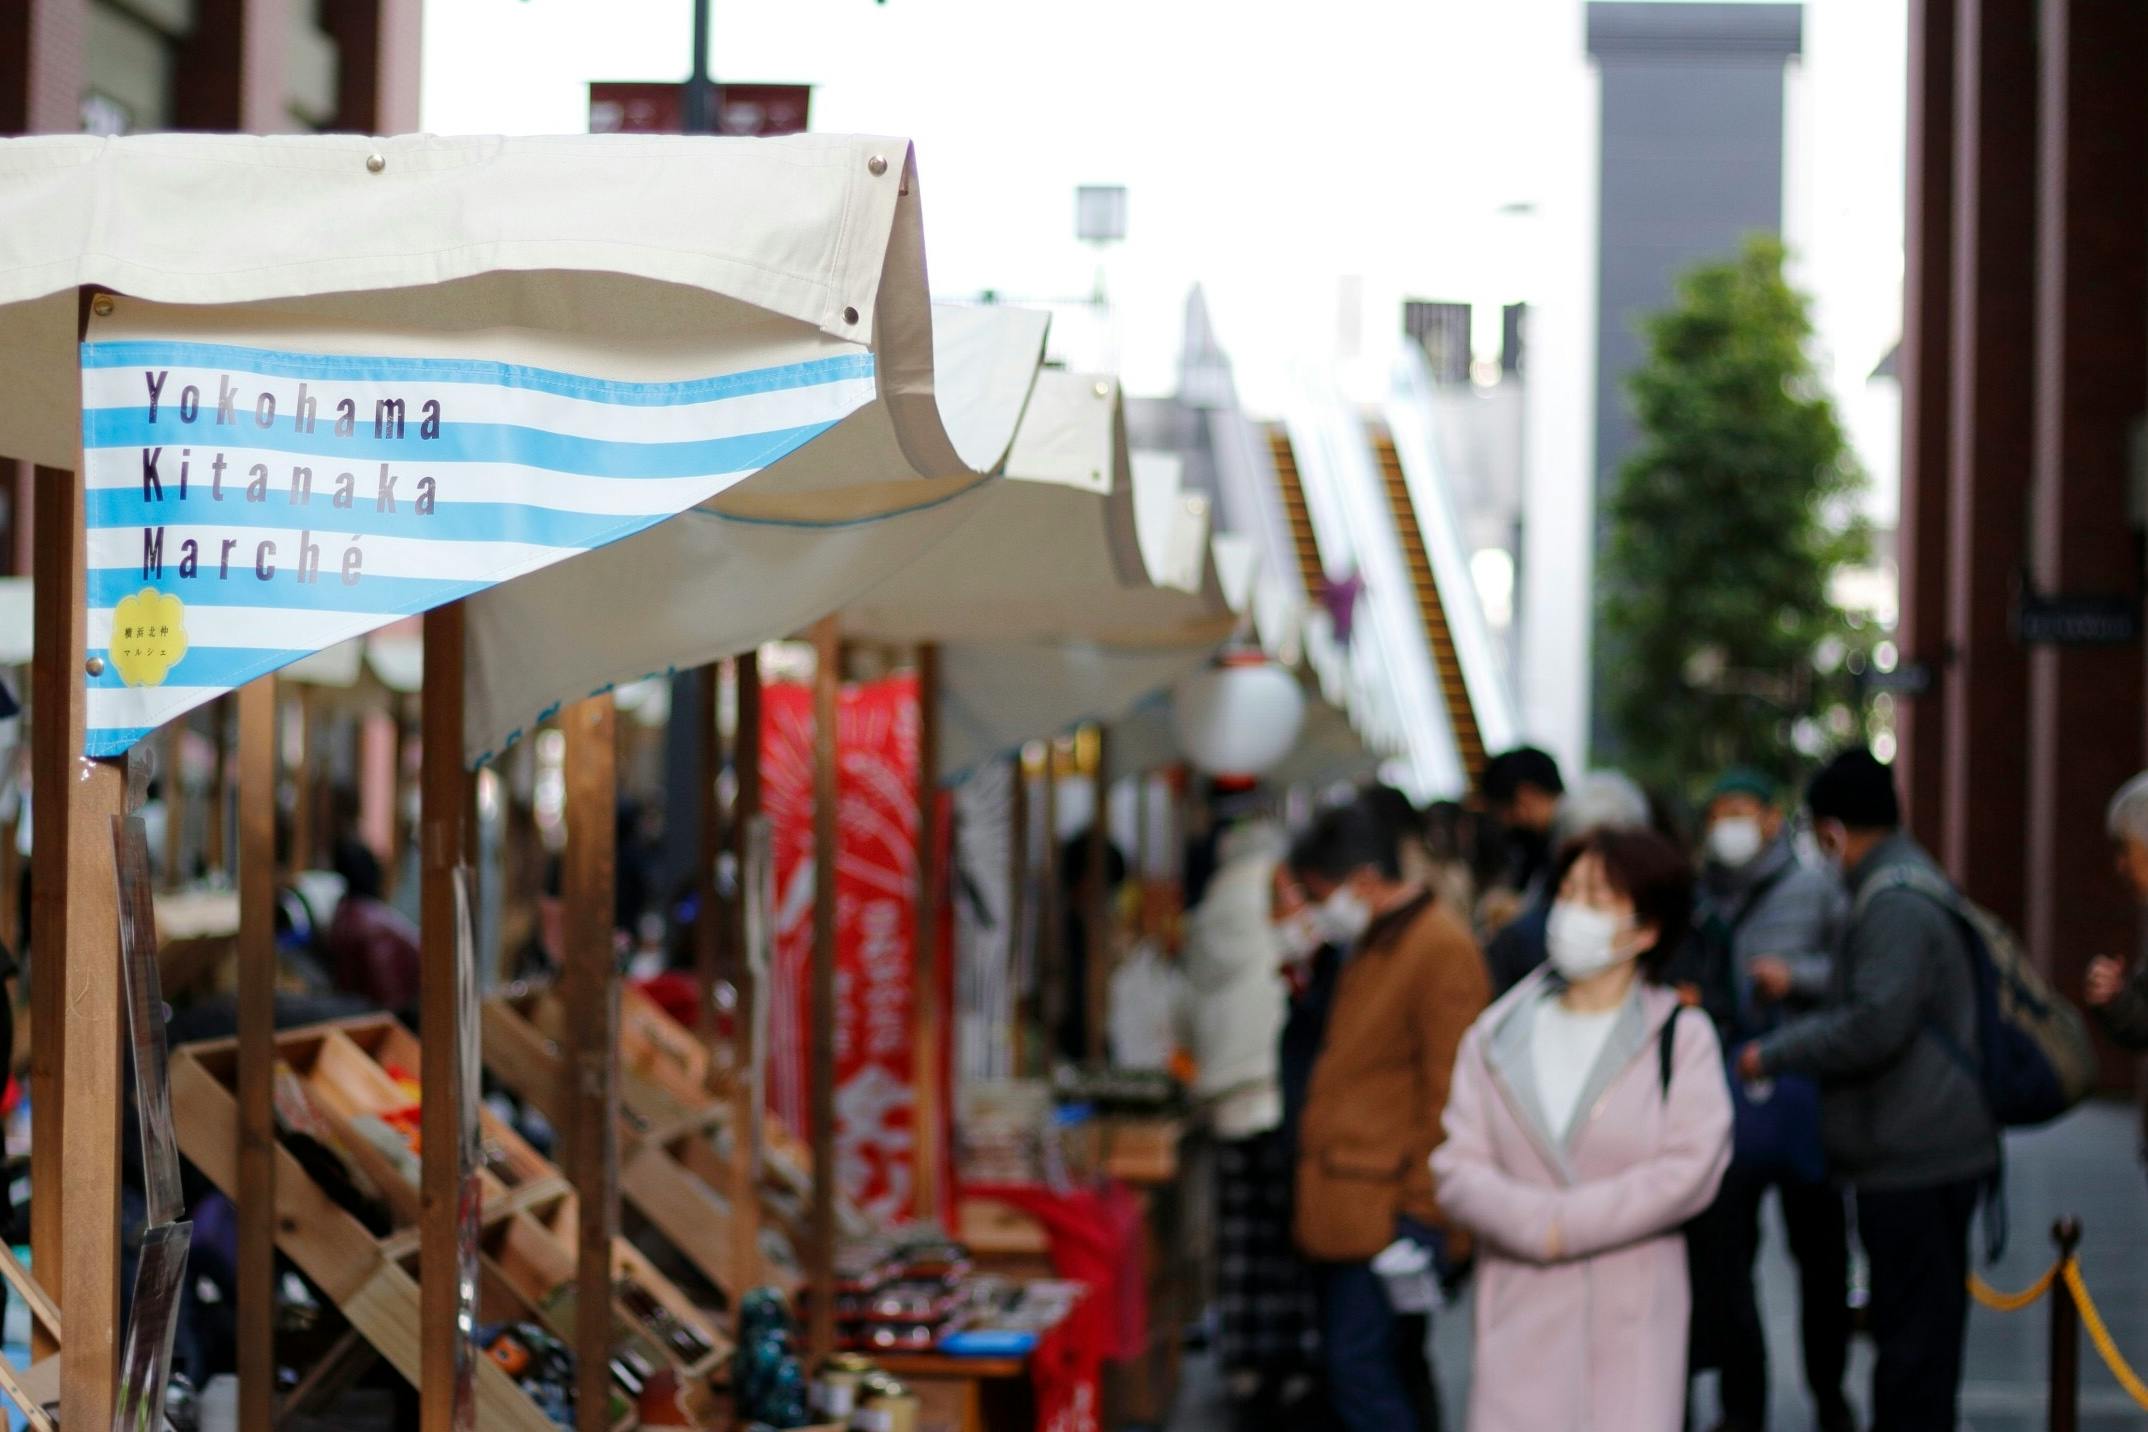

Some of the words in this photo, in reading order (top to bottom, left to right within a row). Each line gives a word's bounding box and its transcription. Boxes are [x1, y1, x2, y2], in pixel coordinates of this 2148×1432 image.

[145, 371, 441, 440] Yokohama
[143, 447, 436, 516] Kitanaka
[143, 526, 363, 587] Marché
[124, 648, 167, 656] マルシェ
